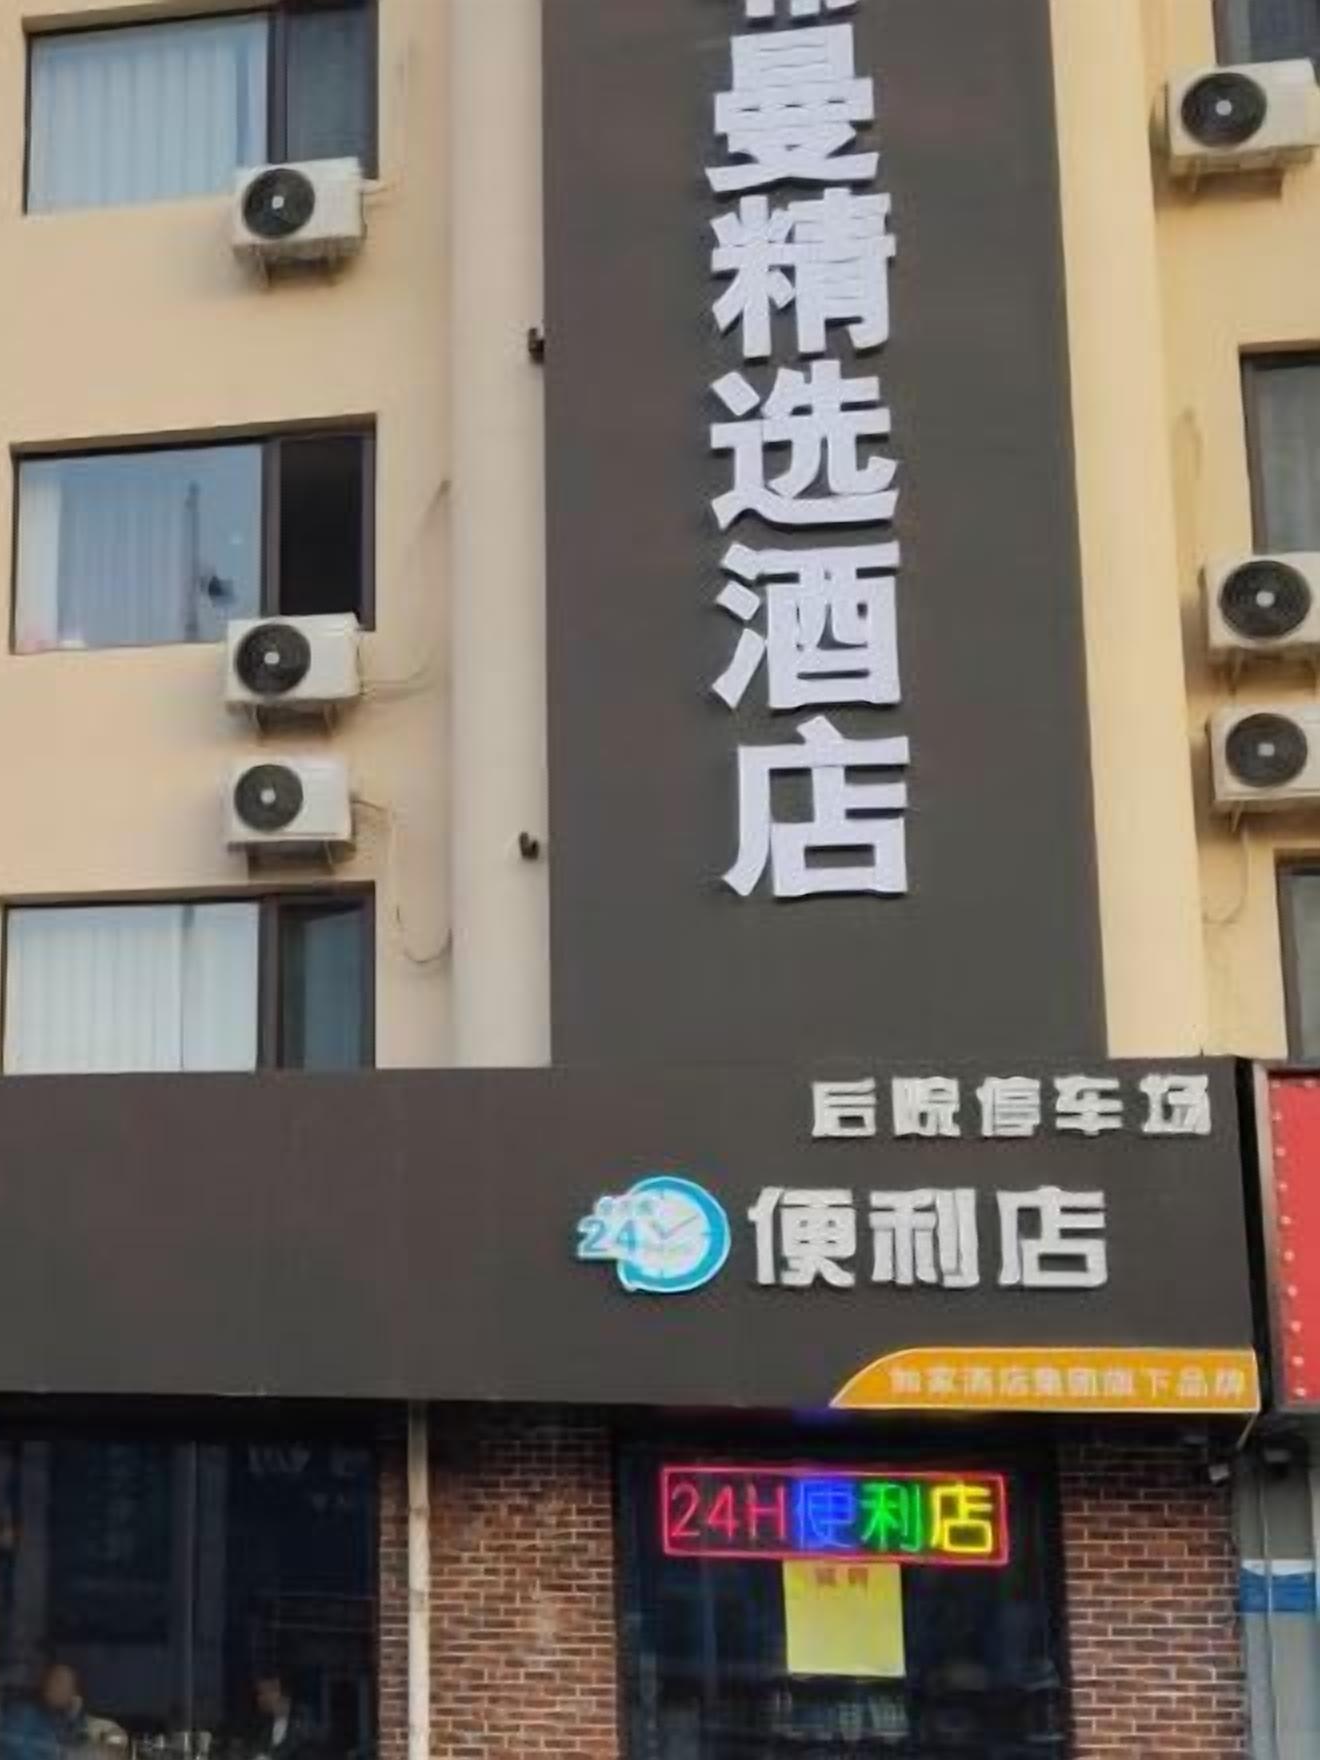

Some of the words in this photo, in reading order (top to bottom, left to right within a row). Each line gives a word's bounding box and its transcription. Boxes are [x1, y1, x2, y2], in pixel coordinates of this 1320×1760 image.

[707, 0, 911, 896] 曼精选酒店
[811, 1074, 1212, 1137] 后院停车场
[748, 1185, 1108, 1288] 便利店
